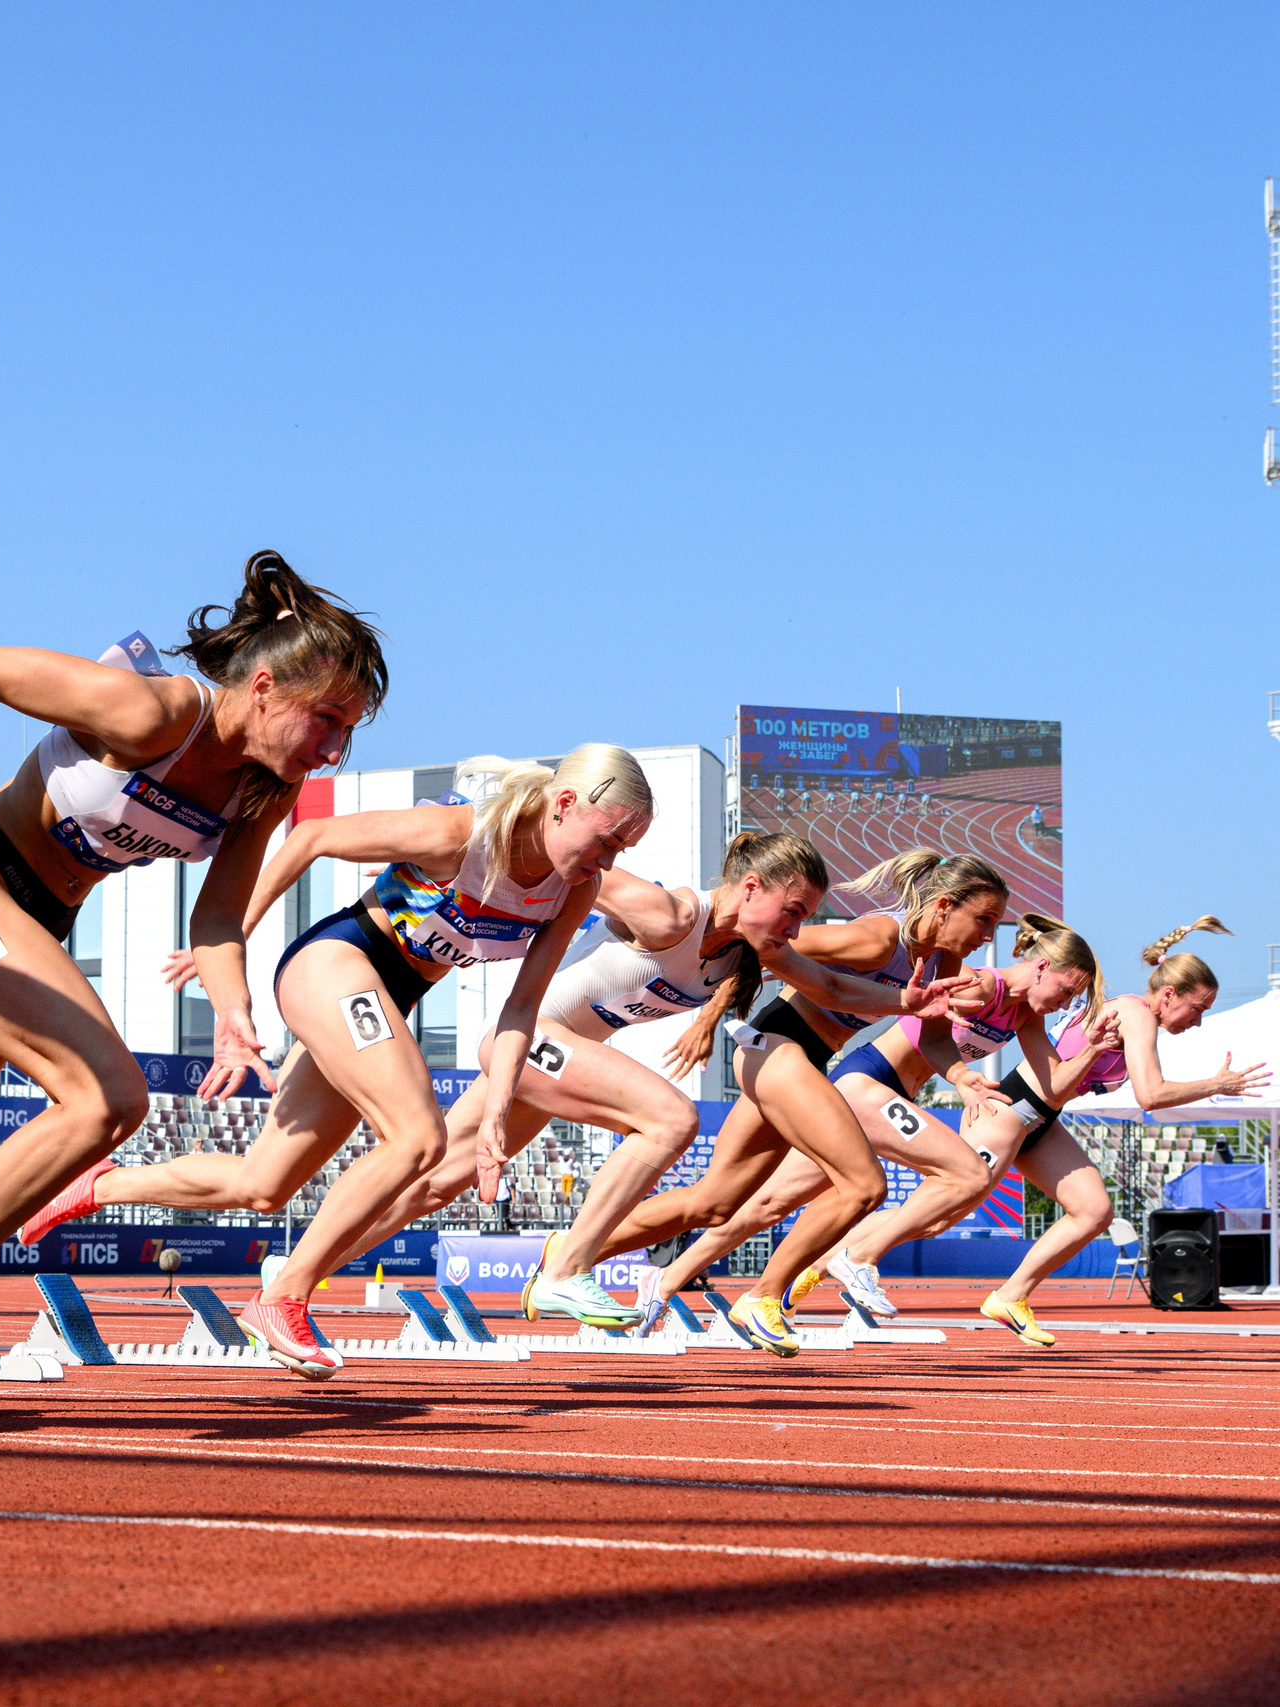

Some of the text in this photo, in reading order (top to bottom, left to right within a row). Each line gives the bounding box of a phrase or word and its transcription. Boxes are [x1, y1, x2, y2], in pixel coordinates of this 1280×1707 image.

[754, 719, 870, 739] 100 МЕТРОВ
[778, 741, 848, 752] ЖЕНЩИНЫ
[789, 751, 838, 760] 4 ЗАБЕГ
[143, 787, 177, 811] ПСБ
[173, 811, 201, 827] РОССИИ
[181, 806, 218, 827] ЧЕМПИОНАТ
[659, 987, 680, 1000] ПСБ
[350, 997, 381, 1041] 6
[974, 1023, 990, 1034] ПСБ
[528, 1043, 565, 1072] 5
[888, 1103, 919, 1135] 3
[61, 1232, 118, 1240] ГЕНЕРАЛЬНЫЙ ПАРТНЁР
[166, 1238, 201, 1246] РОССИЙСКАЯ
[2, 1243, 40, 1264] ПСБ
[81, 1243, 119, 1264] ПСБ
[616, 1254, 644, 1262] ПАРТНЁР
[380, 1258, 421, 1266] ПОЛИПЛАСТ
[479, 1262, 537, 1278] ВФЛА
